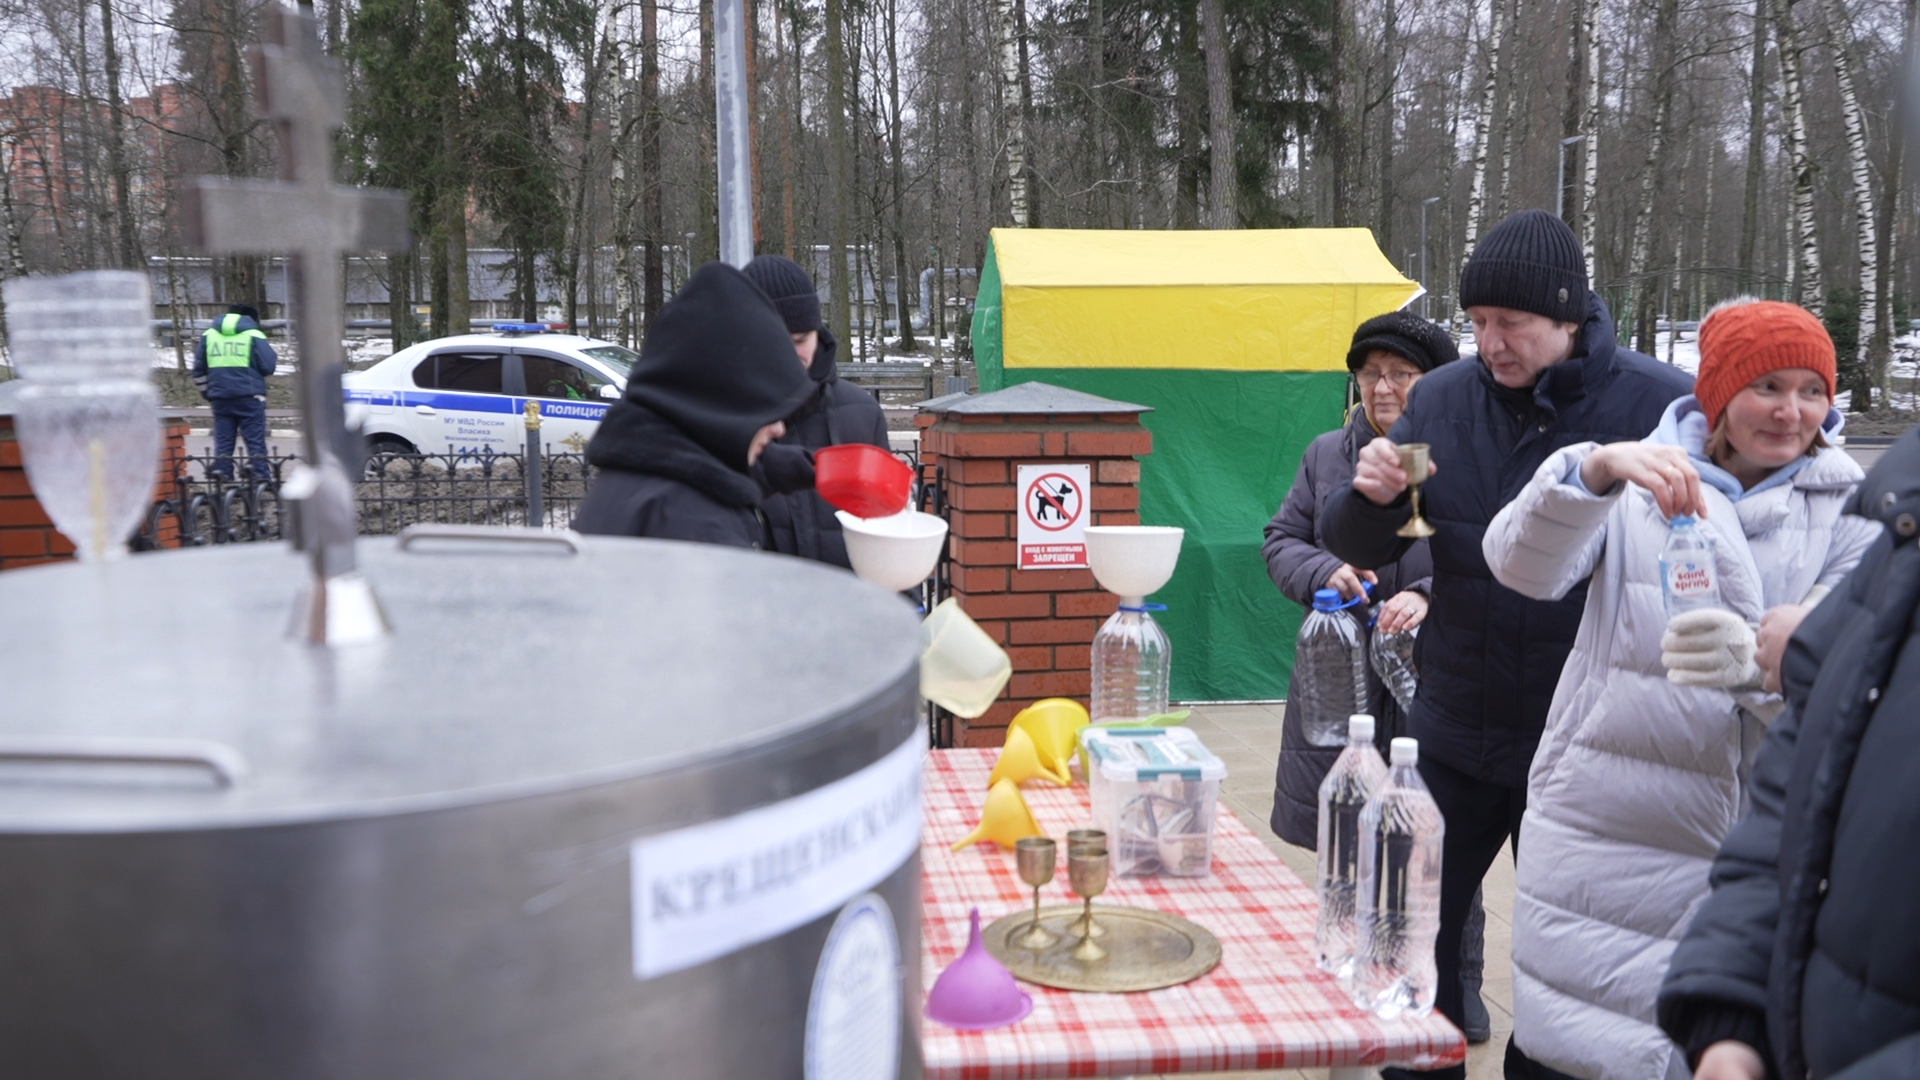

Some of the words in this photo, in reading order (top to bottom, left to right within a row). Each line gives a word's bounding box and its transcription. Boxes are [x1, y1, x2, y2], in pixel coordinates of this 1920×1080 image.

[209, 342, 246, 357] ДПС
[546, 404, 606, 418] ПОЛИЦИЯ
[457, 418, 475, 426] МВД
[457, 427, 491, 435] Власиха
[1033, 553, 1075, 563] ЗАПРЕЩЕН
[1677, 569, 1705, 580] saint
[1675, 578, 1710, 591] spring
